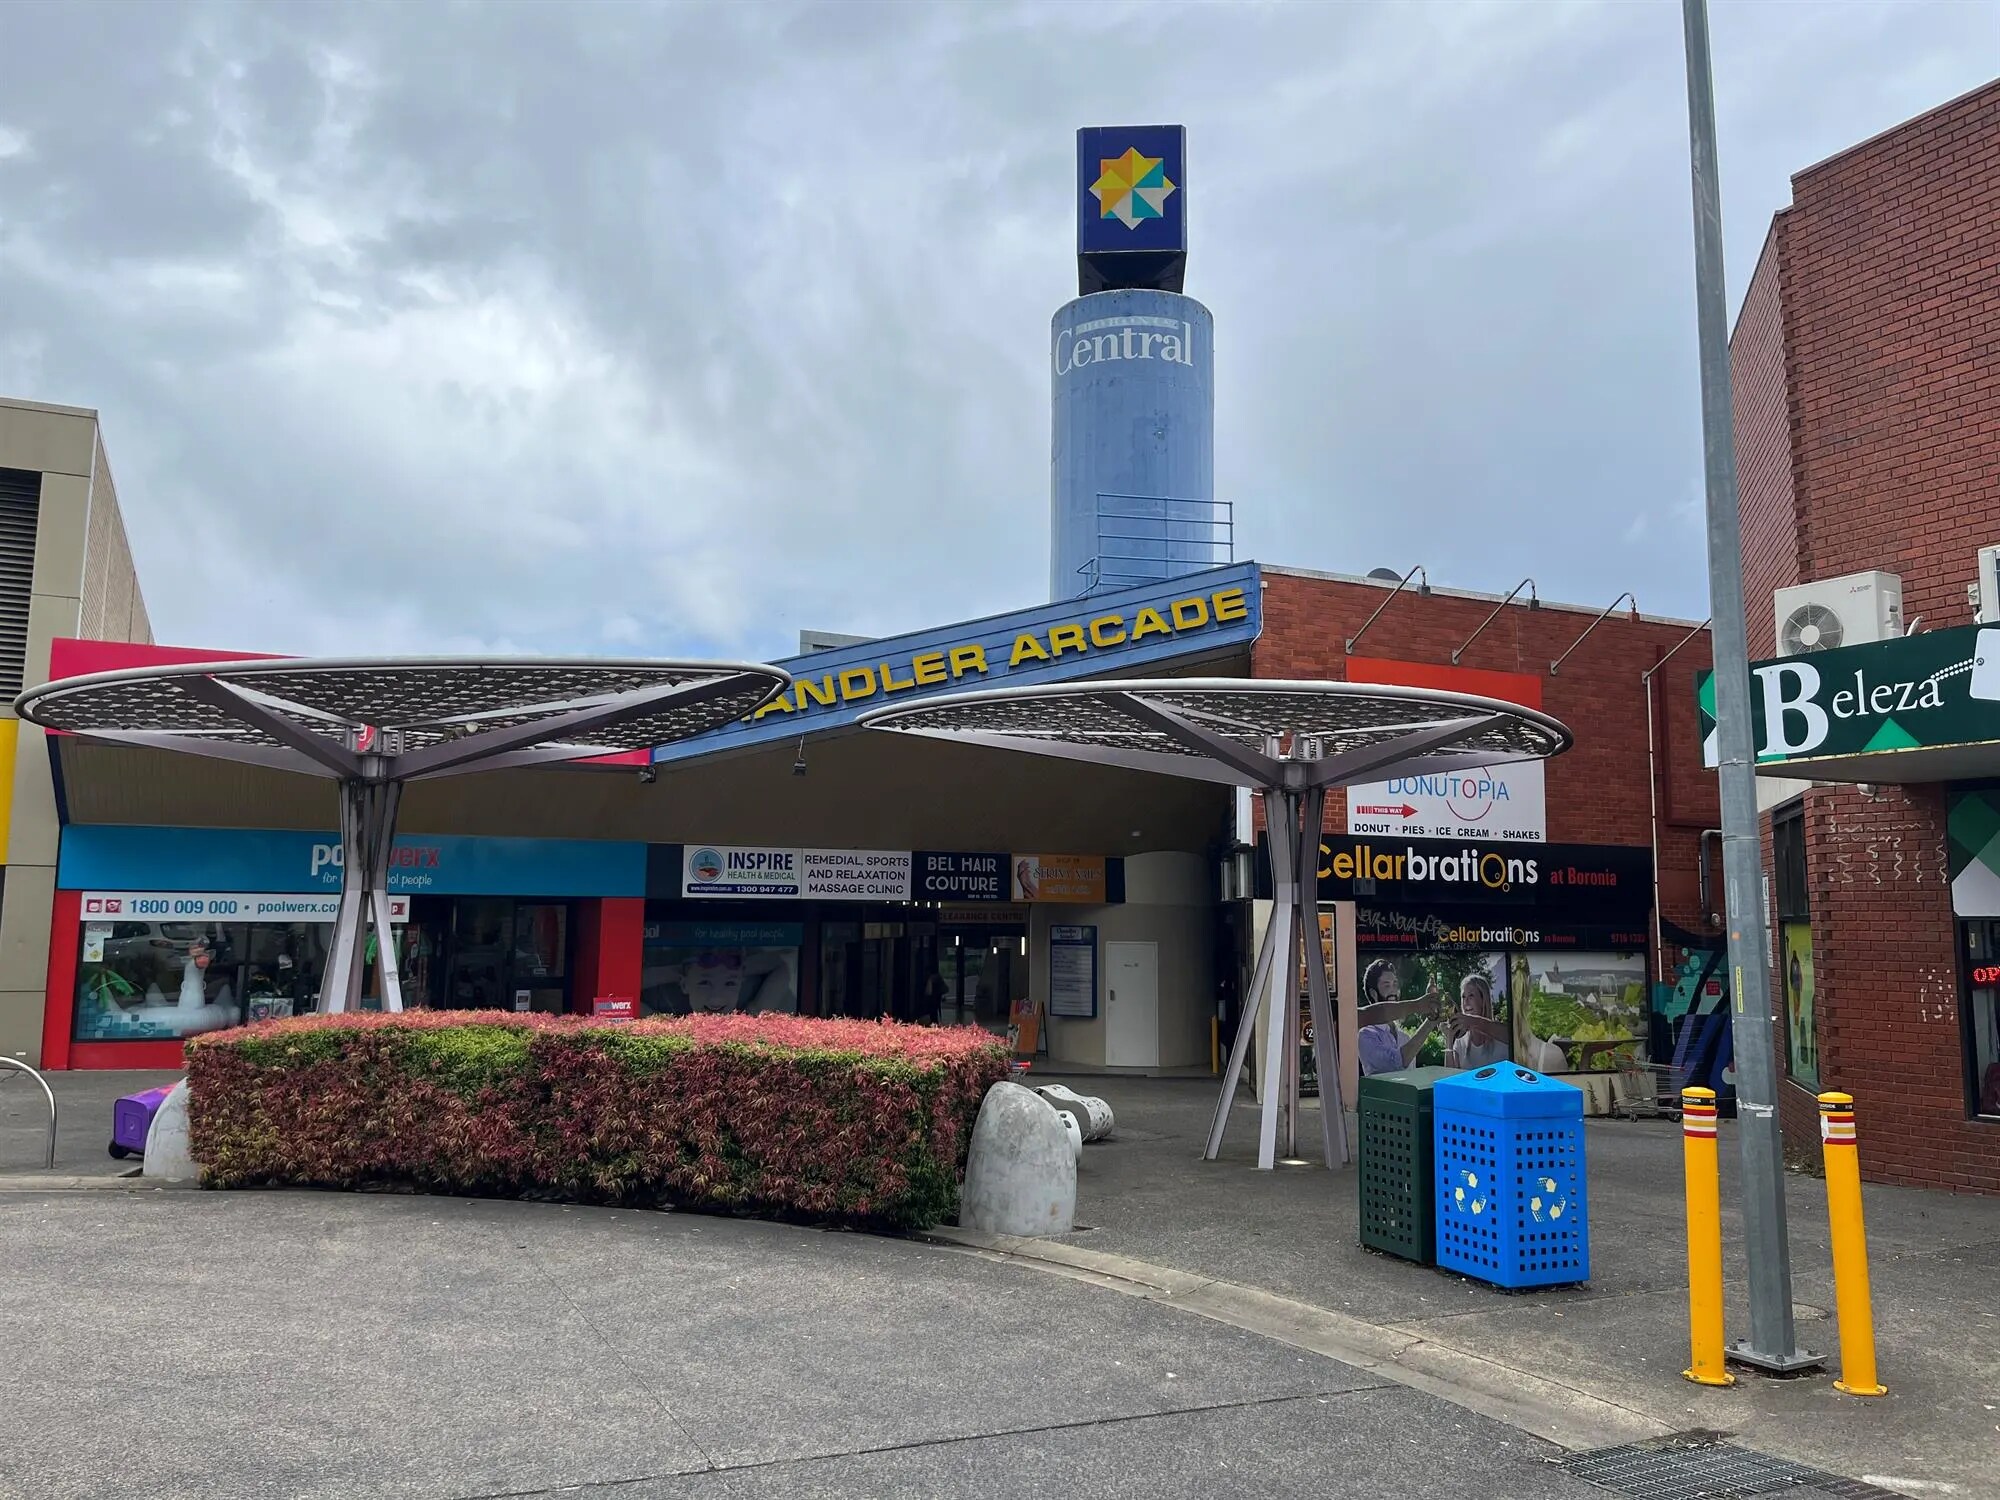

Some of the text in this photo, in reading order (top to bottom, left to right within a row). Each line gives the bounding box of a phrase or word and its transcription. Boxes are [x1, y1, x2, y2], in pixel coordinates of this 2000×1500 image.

[1055, 321, 1193, 376] Central
[742, 588, 1248, 721] ANDLER ARCADE
[1753, 662, 1944, 757] Beleza
[1388, 776, 1510, 801] DONUTOPIA
[1354, 823, 1540, 840] DONUT PIES ICE CREAM SHAKES
[311, 843, 441, 877] poerx
[728, 852, 793, 871] INSPIRE
[804, 855, 910, 867] REMEDIAL, SPORTS
[927, 857, 997, 872] BEL HAIR
[323, 871, 338, 884] for
[402, 873, 433, 889] people
[727, 870, 796, 881] HEALTH & MEDICAL
[808, 869, 905, 881] AND RELAXATION
[1550, 869, 1564, 884] at
[1568, 867, 1617, 887] Boronia
[778, 886, 794, 894] 477
[809, 884, 904, 895] MASSAGE CLINIC
[925, 876, 998, 892] COUTURE
[130, 899, 169, 914] 1800
[174, 900, 203, 914] 009
[208, 900, 238, 914] 000
[938, 911, 1024, 922] CLEARANCE CENTRE
[1357, 933, 1376, 944] open
